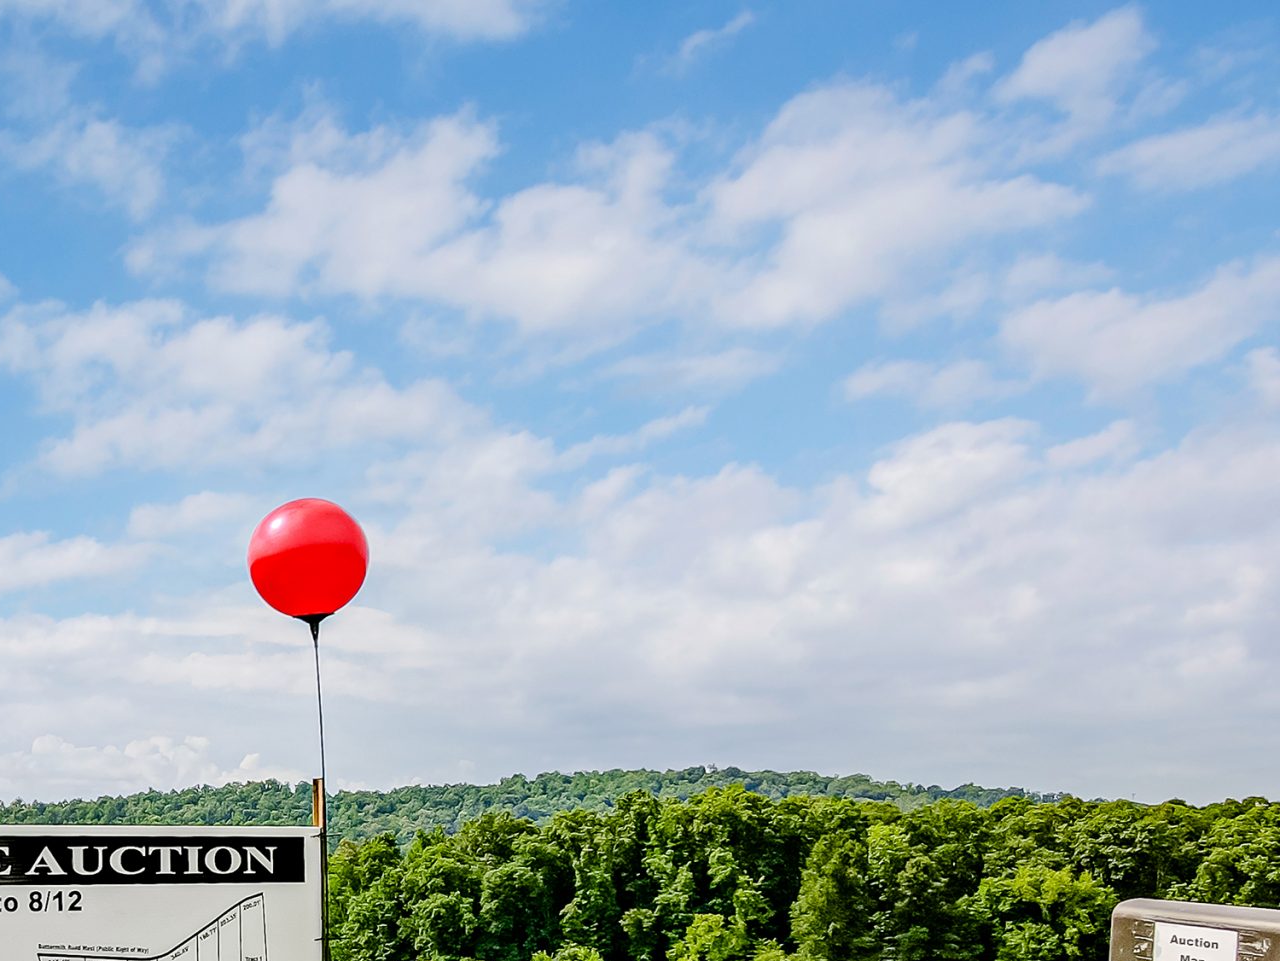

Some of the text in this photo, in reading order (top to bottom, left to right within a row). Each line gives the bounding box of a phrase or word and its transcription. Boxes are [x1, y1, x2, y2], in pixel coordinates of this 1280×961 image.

[24, 845, 278, 876] AUCTION
[28, 890, 83, 912] 8/12
[1170, 934, 1219, 949] Auction
